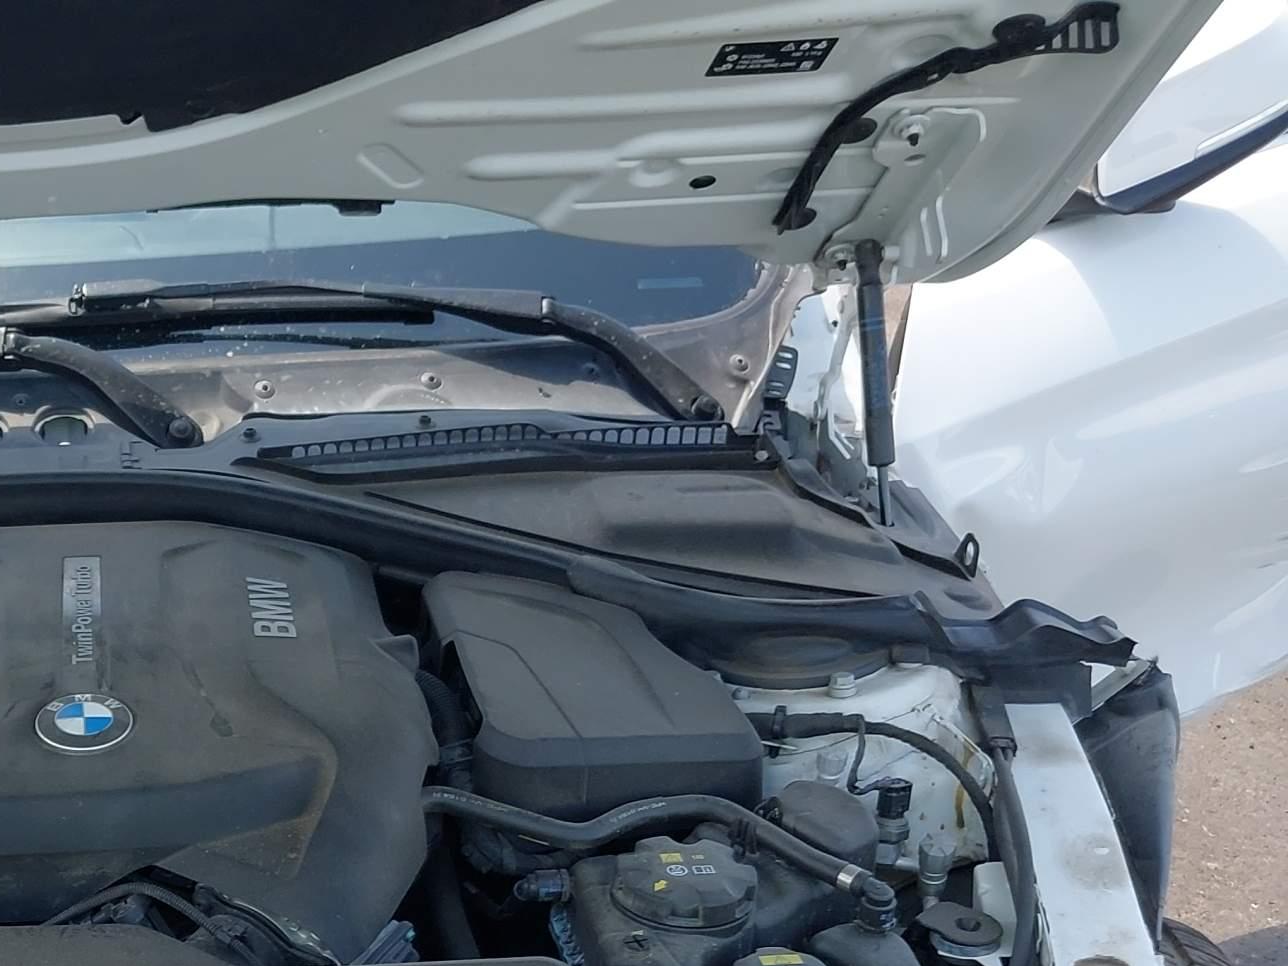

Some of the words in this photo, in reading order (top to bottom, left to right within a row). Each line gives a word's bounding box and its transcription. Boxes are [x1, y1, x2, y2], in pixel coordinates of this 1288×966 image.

[71, 563, 93, 597] Turbo
[245, 576, 297, 638] BMW
[46, 693, 123, 712] BMW
